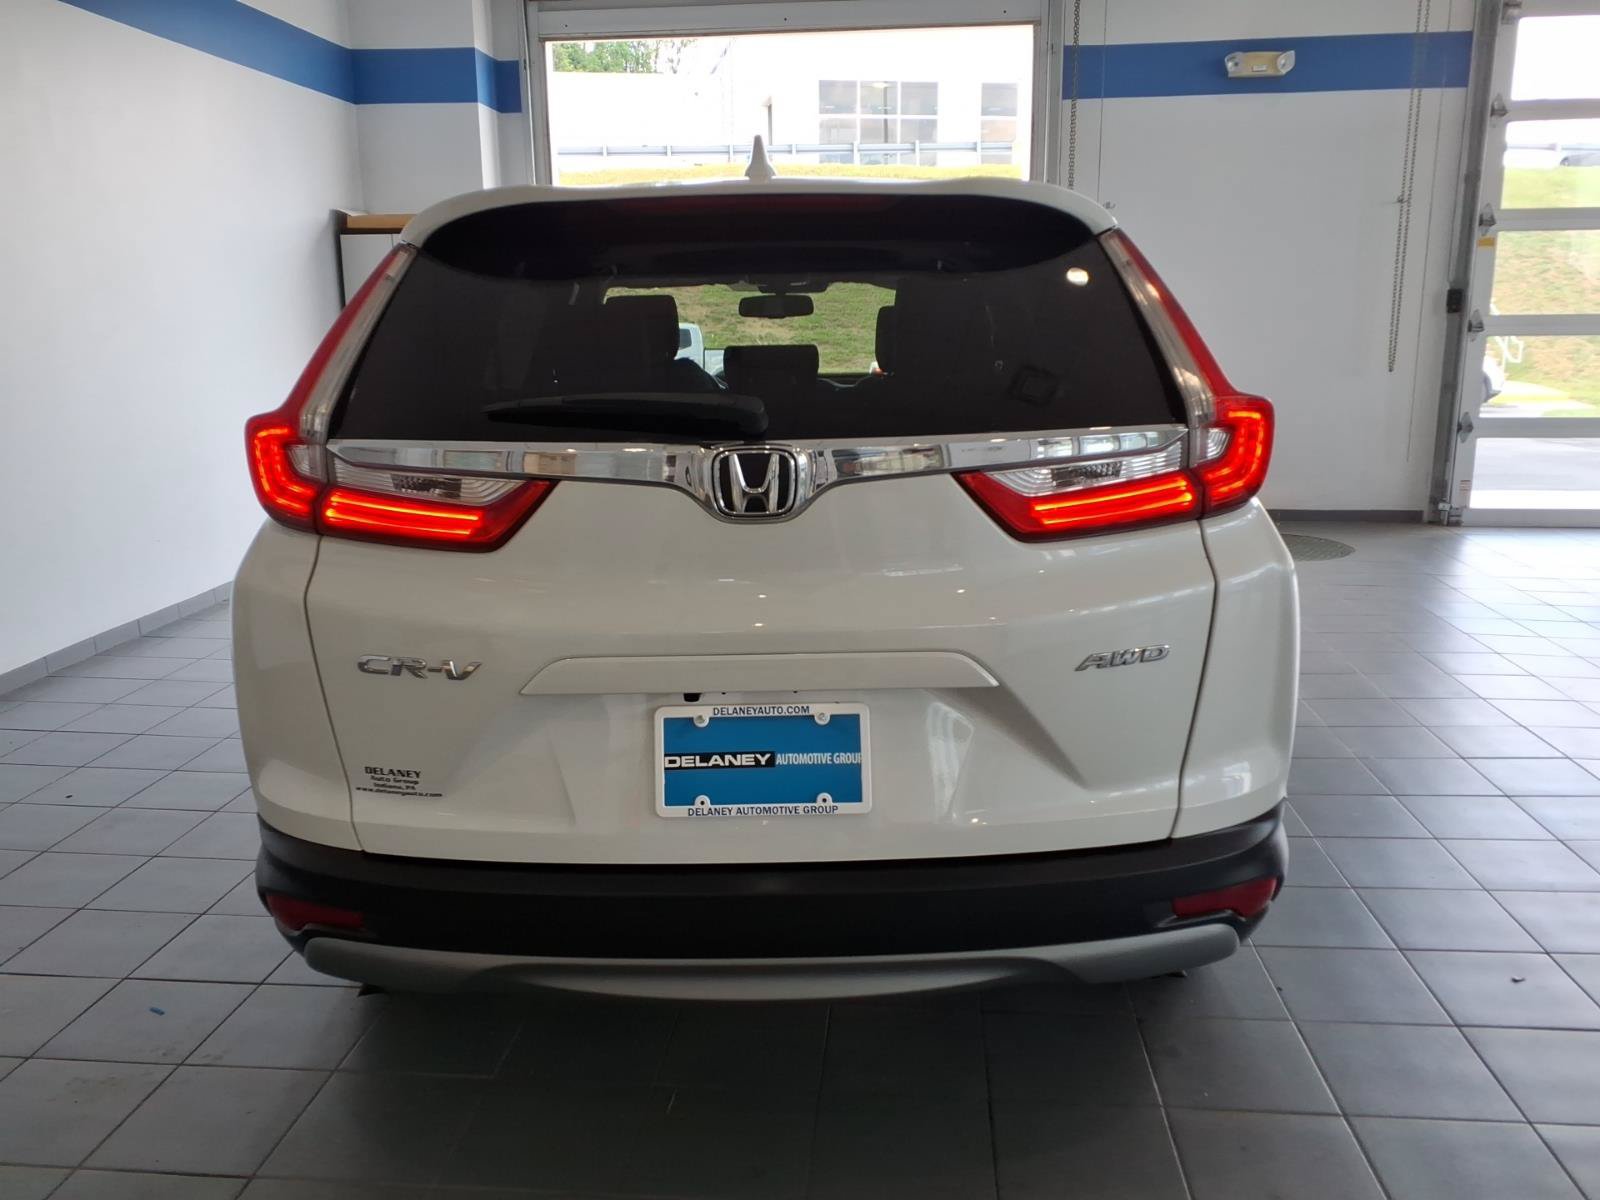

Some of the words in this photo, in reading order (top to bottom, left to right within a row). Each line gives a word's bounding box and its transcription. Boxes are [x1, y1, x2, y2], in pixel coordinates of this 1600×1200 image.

[1074, 644, 1170, 672] AWD
[357, 654, 482, 681] CR-V
[713, 705, 810, 717] DELANEYAUTO.COM
[664, 753, 771, 768] DELANEY
[776, 752, 833, 765] AUTOMOTIVE
[365, 766, 421, 778] DELANEY
[688, 806, 734, 817] DELANEY
[736, 805, 800, 816] AUTOMOTIVE
[803, 805, 839, 815] GROUP
